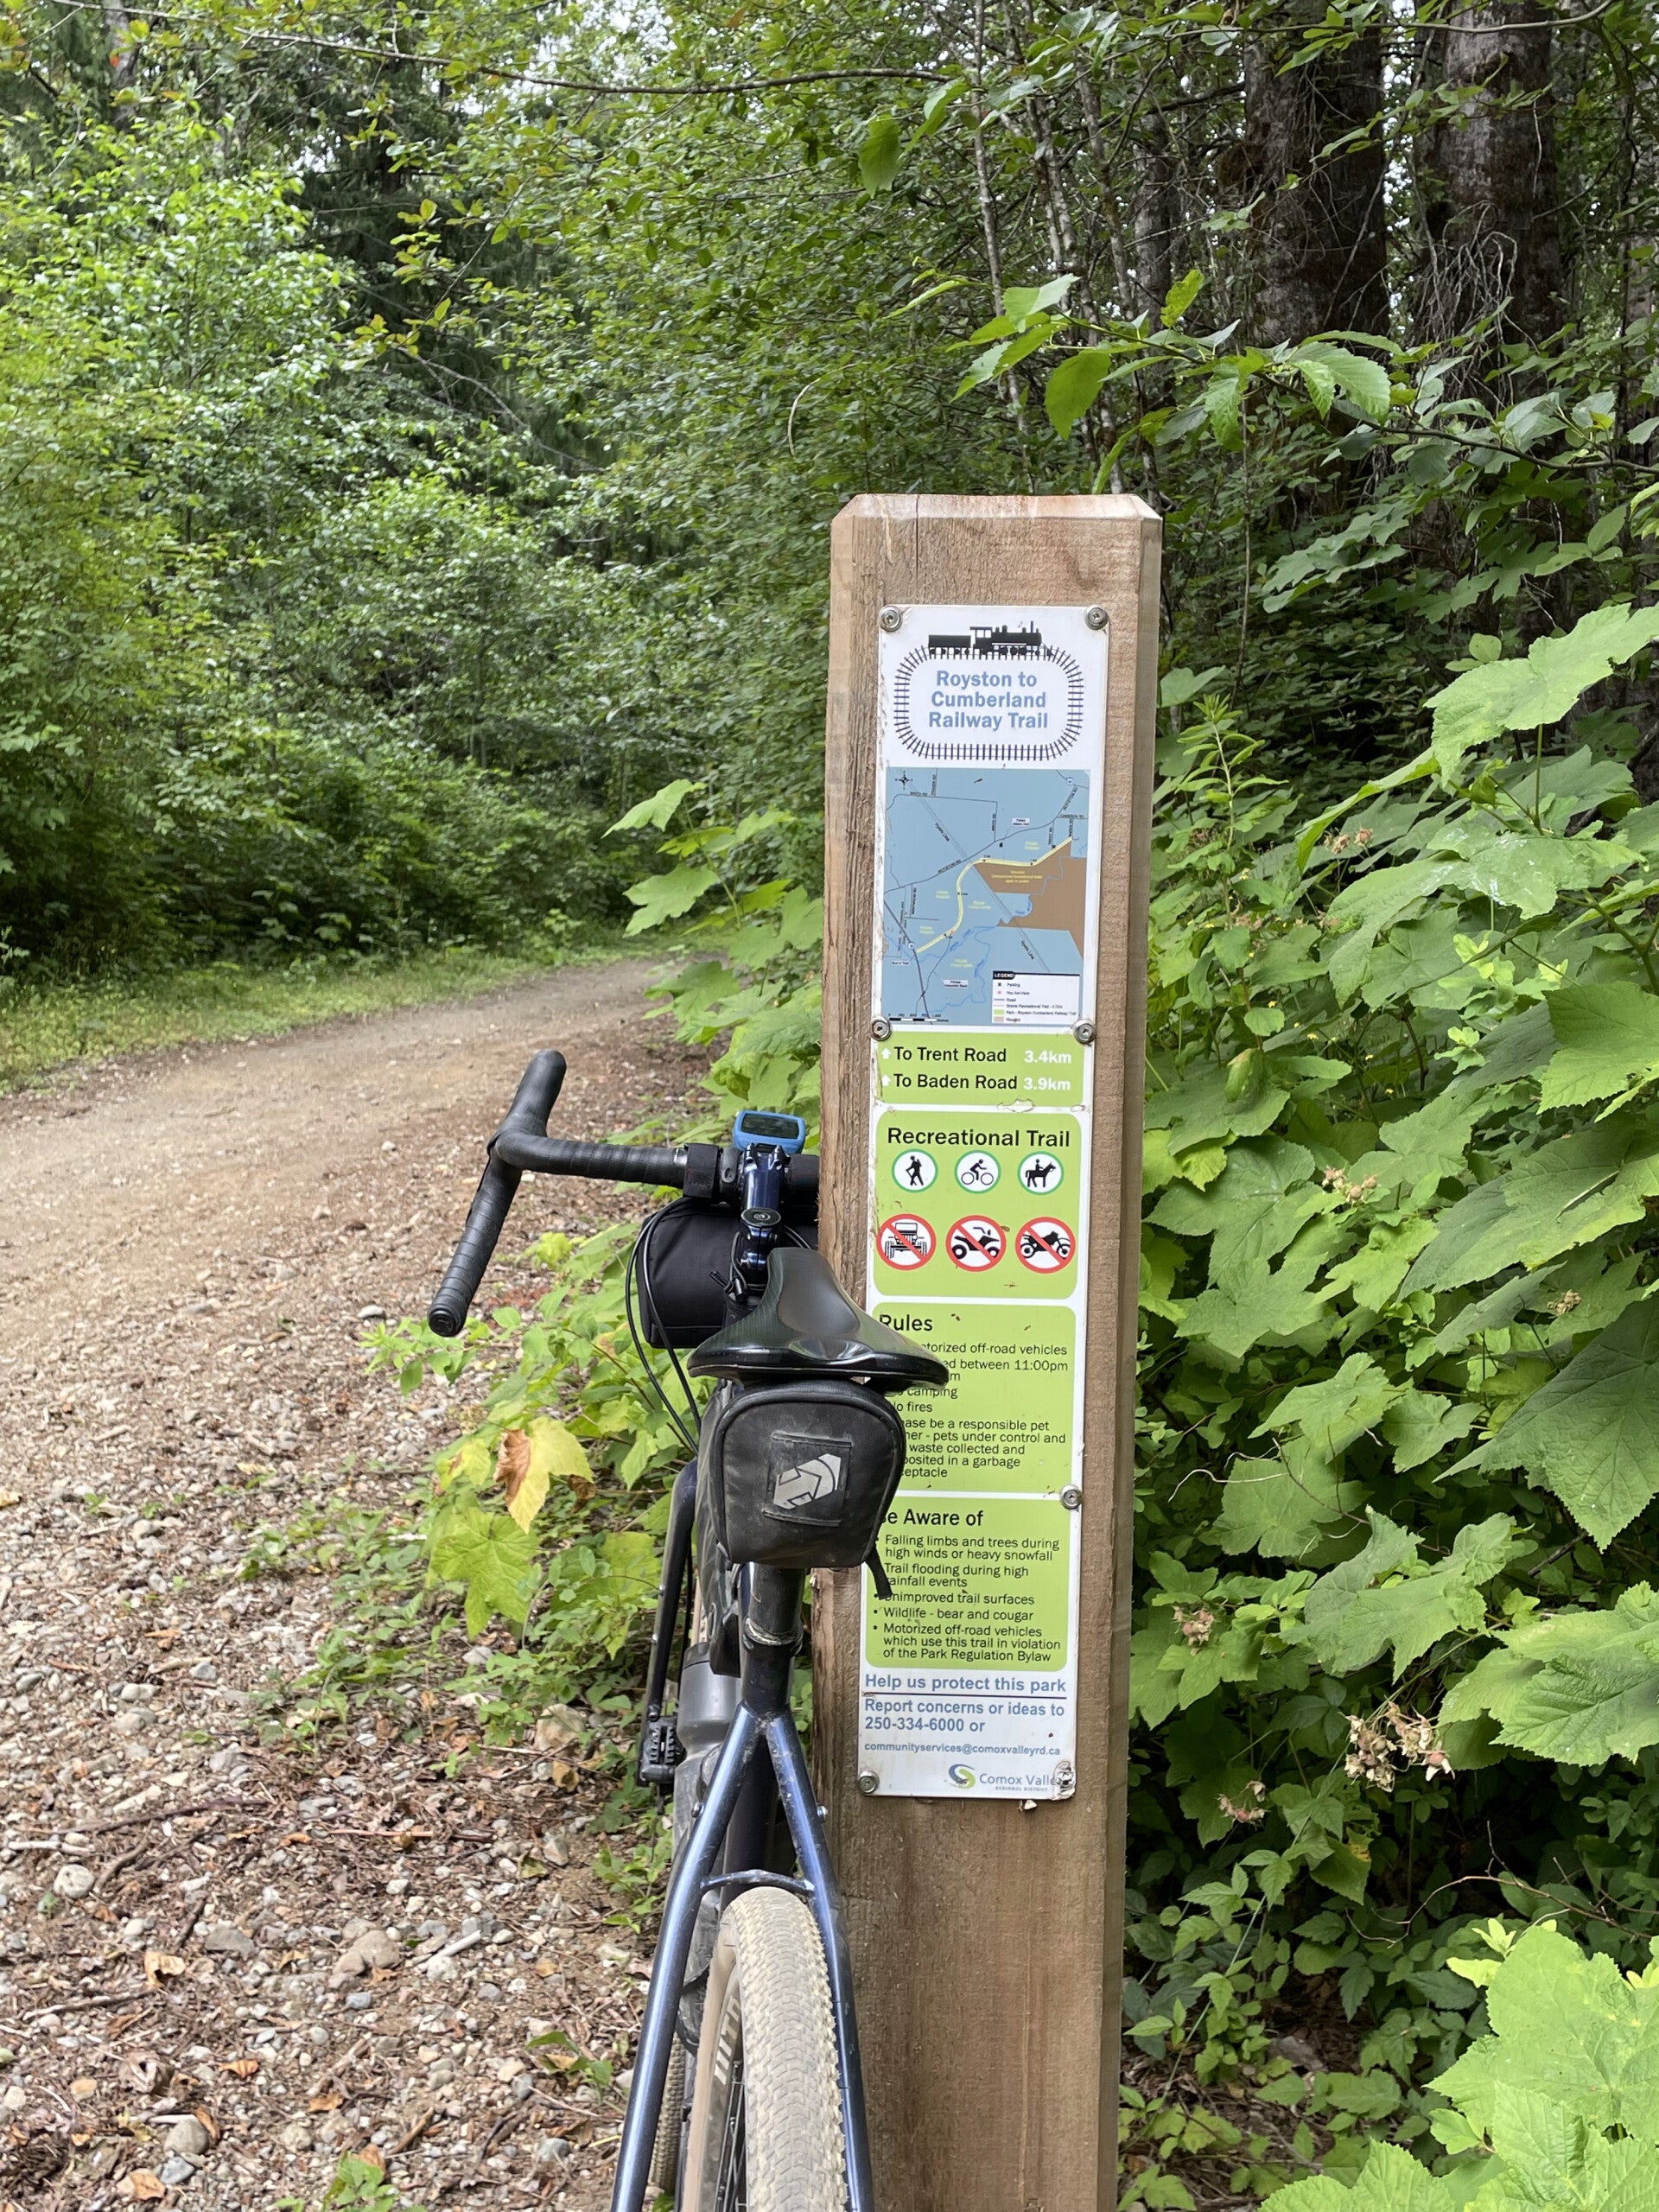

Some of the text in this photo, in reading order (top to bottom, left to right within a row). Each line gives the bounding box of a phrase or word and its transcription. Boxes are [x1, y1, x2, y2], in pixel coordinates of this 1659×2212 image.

[937, 671, 1037, 689] Royston to
[931, 691, 1046, 708] Cumberland
[929, 712, 1048, 731] Railway Trail
[894, 1047, 1071, 1064] To Trent Road 3.4km
[893, 1074, 1071, 1090] To Baden Road 3.9km
[887, 1128, 1070, 1147] Recreational Trail
[880, 1315, 933, 1331] Rules
[970, 1344, 1015, 1354] off-road
[1020, 1344, 1067, 1355] vehicles
[961, 1359, 1009, 1370] between
[1014, 1360, 1068, 1372] 11:00pm
[907, 1402, 932, 1412] fires
[930, 1419, 944, 1428] be
[959, 1420, 1027, 1431] responsible
[1031, 1421, 1049, 1432] pet
[933, 1433, 958, 1442] pets
[963, 1432, 996, 1441] under
[1000, 1433, 1039, 1443] control
[1044, 1433, 1065, 1443] and
[910, 1444, 1025, 1454] waste collected and
[948, 1456, 957, 1465] in
[973, 1457, 1020, 1469] garbage
[904, 1510, 959, 1525] Aware
[966, 1511, 983, 1526] of
[886, 1535, 1059, 1551] Falling limbs and trees during
[886, 1549, 910, 1560] high
[914, 1549, 948, 1559] winds
[967, 1549, 1001, 1561] heavy
[1004, 1550, 1052, 1561] snowfall
[885, 1563, 1028, 1578] Trail flooding during high
[929, 1578, 967, 1587] events
[957, 1593, 980, 1604] trail
[983, 1594, 1034, 1605] surfaces
[884, 1607, 926, 1618] Wildlife
[938, 1609, 963, 1619] bear
[967, 1610, 990, 1620] and
[994, 1611, 1033, 1623] cougar
[884, 1624, 1042, 1637] Motorized off-road vehicles
[884, 1636, 1060, 1649] which use this trail in violation
[884, 1648, 1051, 1662] of the Park Regulation Bylaw
[866, 1675, 1065, 1693] Help us protect this park
[865, 1700, 1064, 1716] Report concerns or ideas to
[866, 1717, 985, 1732] 250-334-6000 or
[865, 1742, 1059, 1756] communityservices@comoxvalleyrd.ca
[980, 1774, 1060, 1786] Comox Valle
